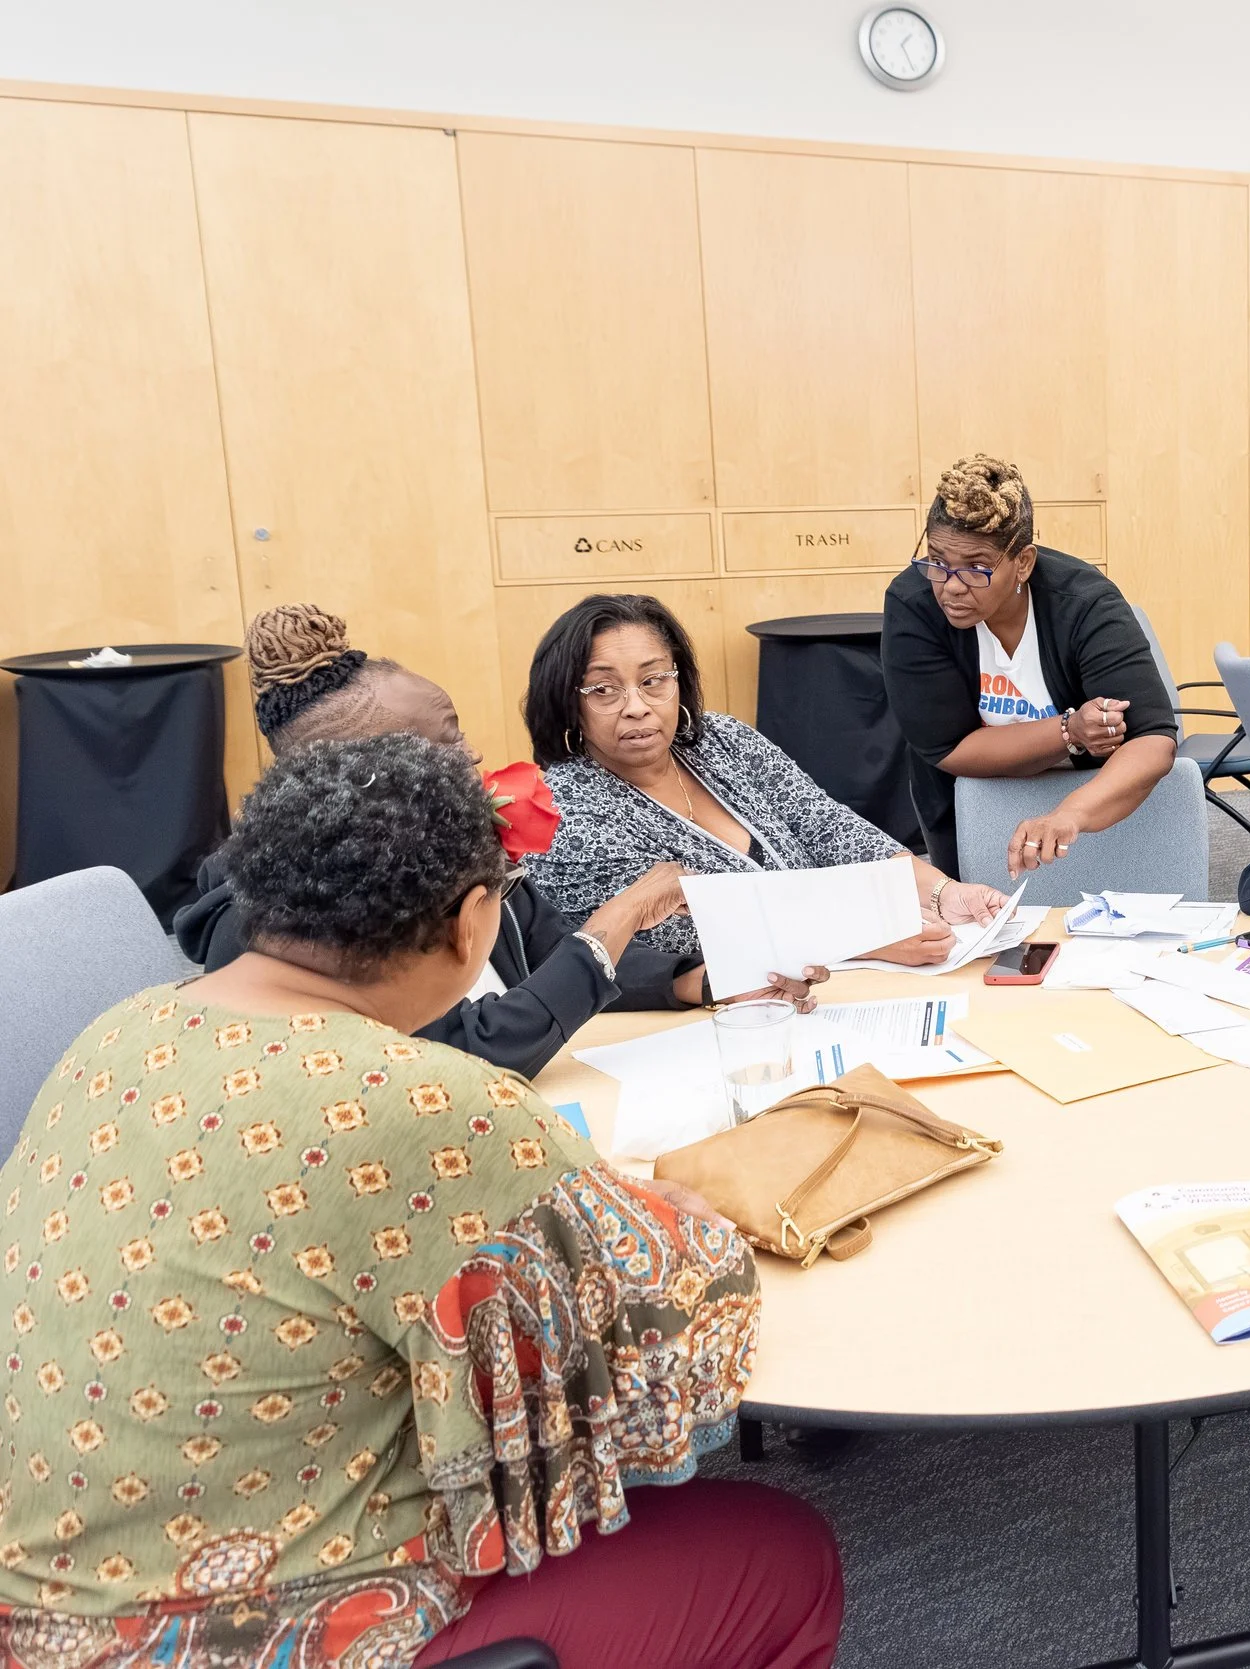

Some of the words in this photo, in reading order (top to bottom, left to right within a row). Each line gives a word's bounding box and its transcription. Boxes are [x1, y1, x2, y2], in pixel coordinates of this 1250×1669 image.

[596, 539, 643, 552] CANS
[795, 533, 850, 547] TRASH
[980, 673, 1023, 698] RON
